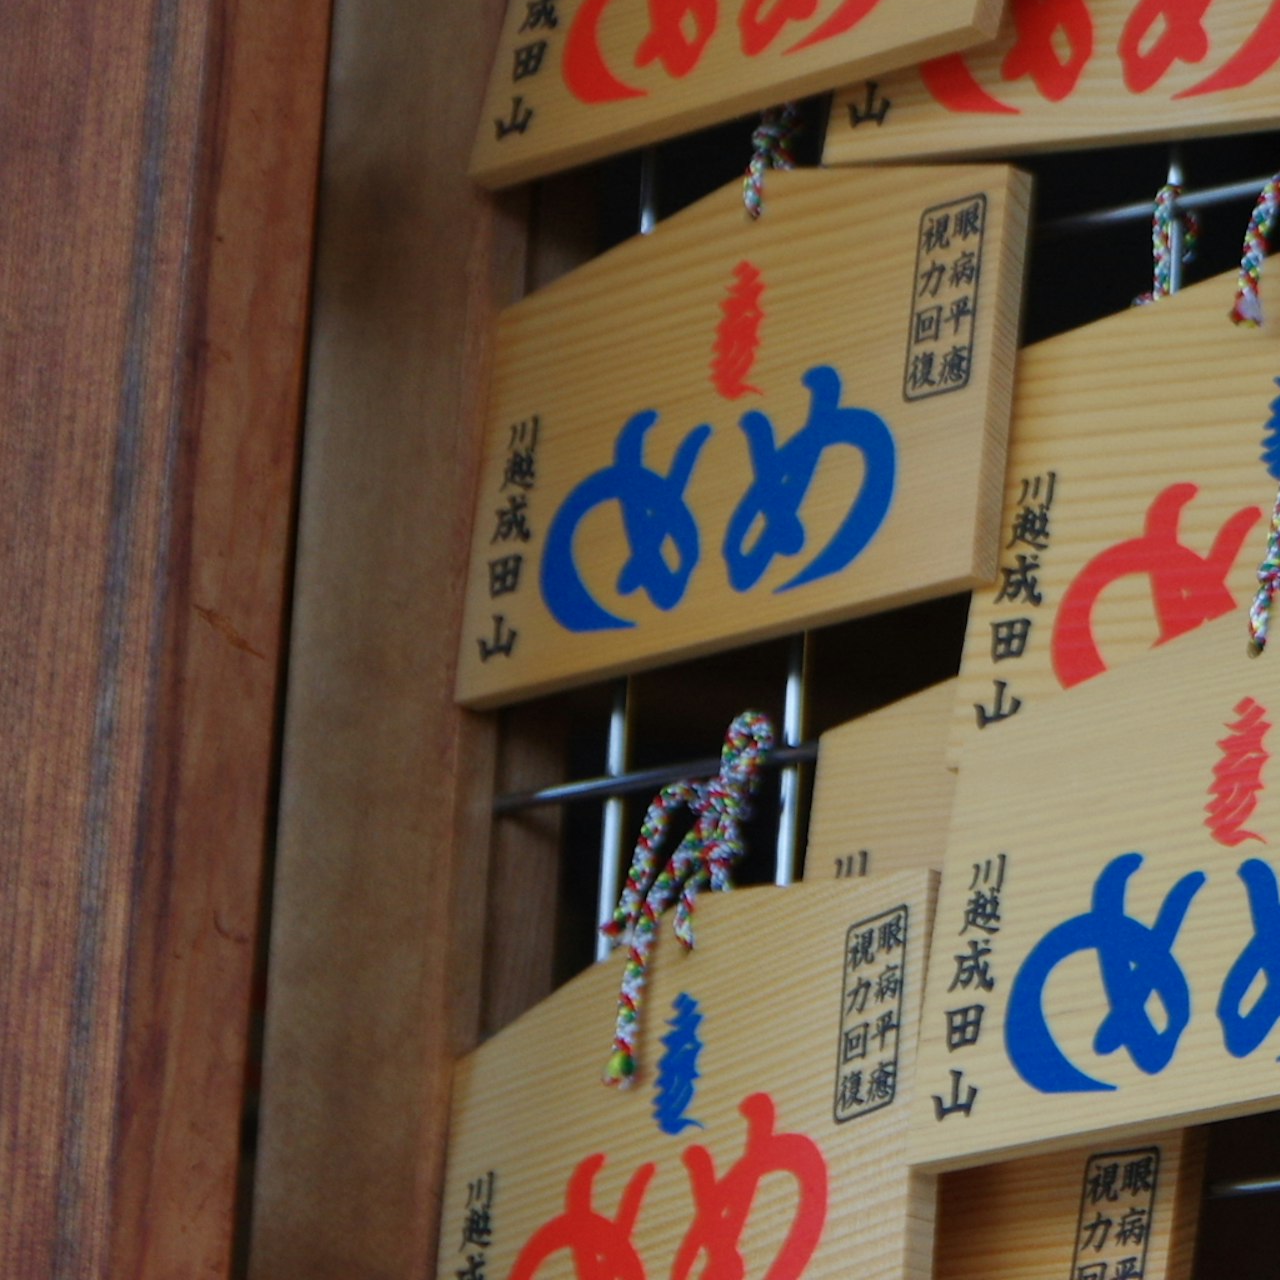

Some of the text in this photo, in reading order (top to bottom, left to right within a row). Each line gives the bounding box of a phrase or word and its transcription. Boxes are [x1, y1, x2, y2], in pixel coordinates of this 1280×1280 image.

[906, 216, 950, 388] 視力回復
[937, 201, 980, 384] 眼病平癒
[477, 416, 539, 662] 川越成田山
[539, 365, 895, 632] めめ
[974, 471, 1057, 729] 川越成田山
[837, 931, 877, 1109] 視力回復
[866, 921, 904, 1102] 眼病平癒
[931, 853, 1006, 1122] 川越成田山
